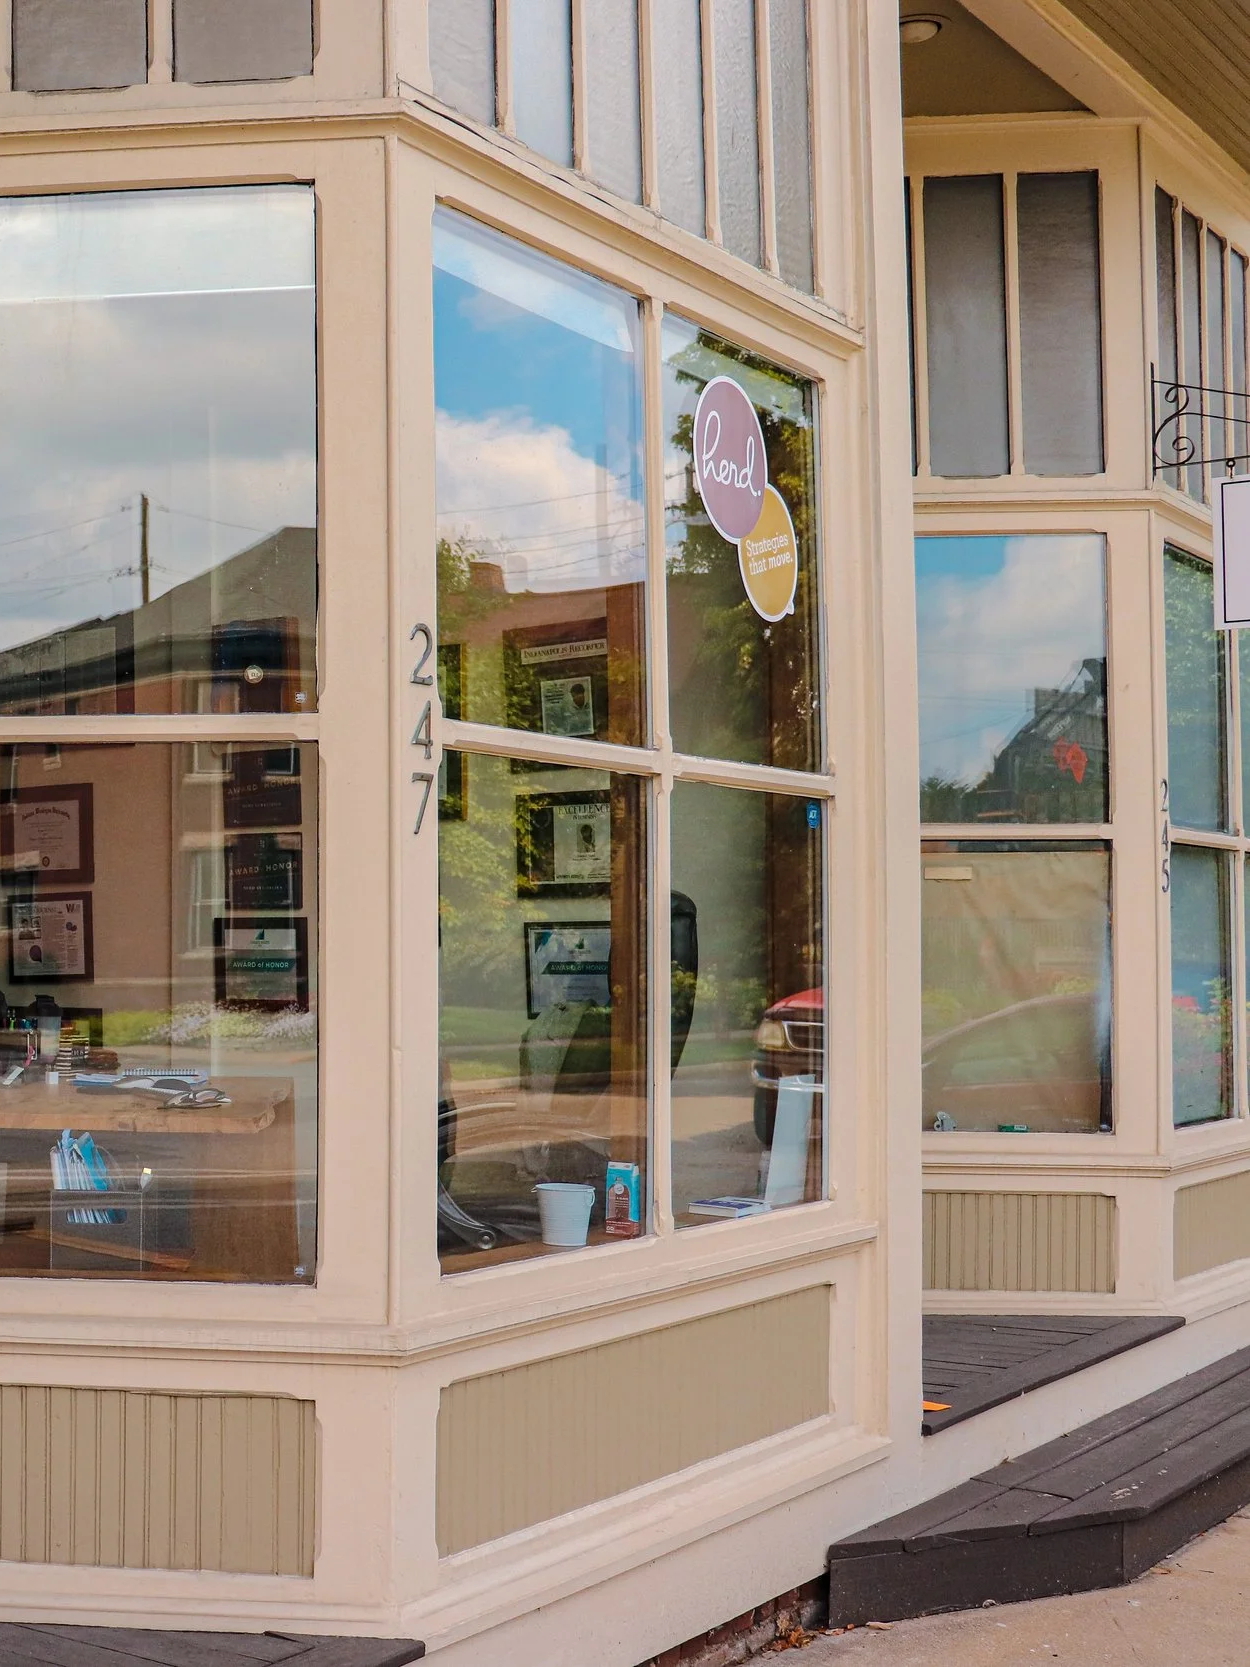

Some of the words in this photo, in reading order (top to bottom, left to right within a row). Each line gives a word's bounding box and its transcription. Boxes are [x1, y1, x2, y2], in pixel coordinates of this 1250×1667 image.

[702, 410, 761, 497] herd.
[746, 532, 789, 557] Strategies
[749, 557, 767, 576] that
[768, 552, 793, 569] move.
[409, 622, 434, 835] 247
[1160, 778, 1170, 893] 245
